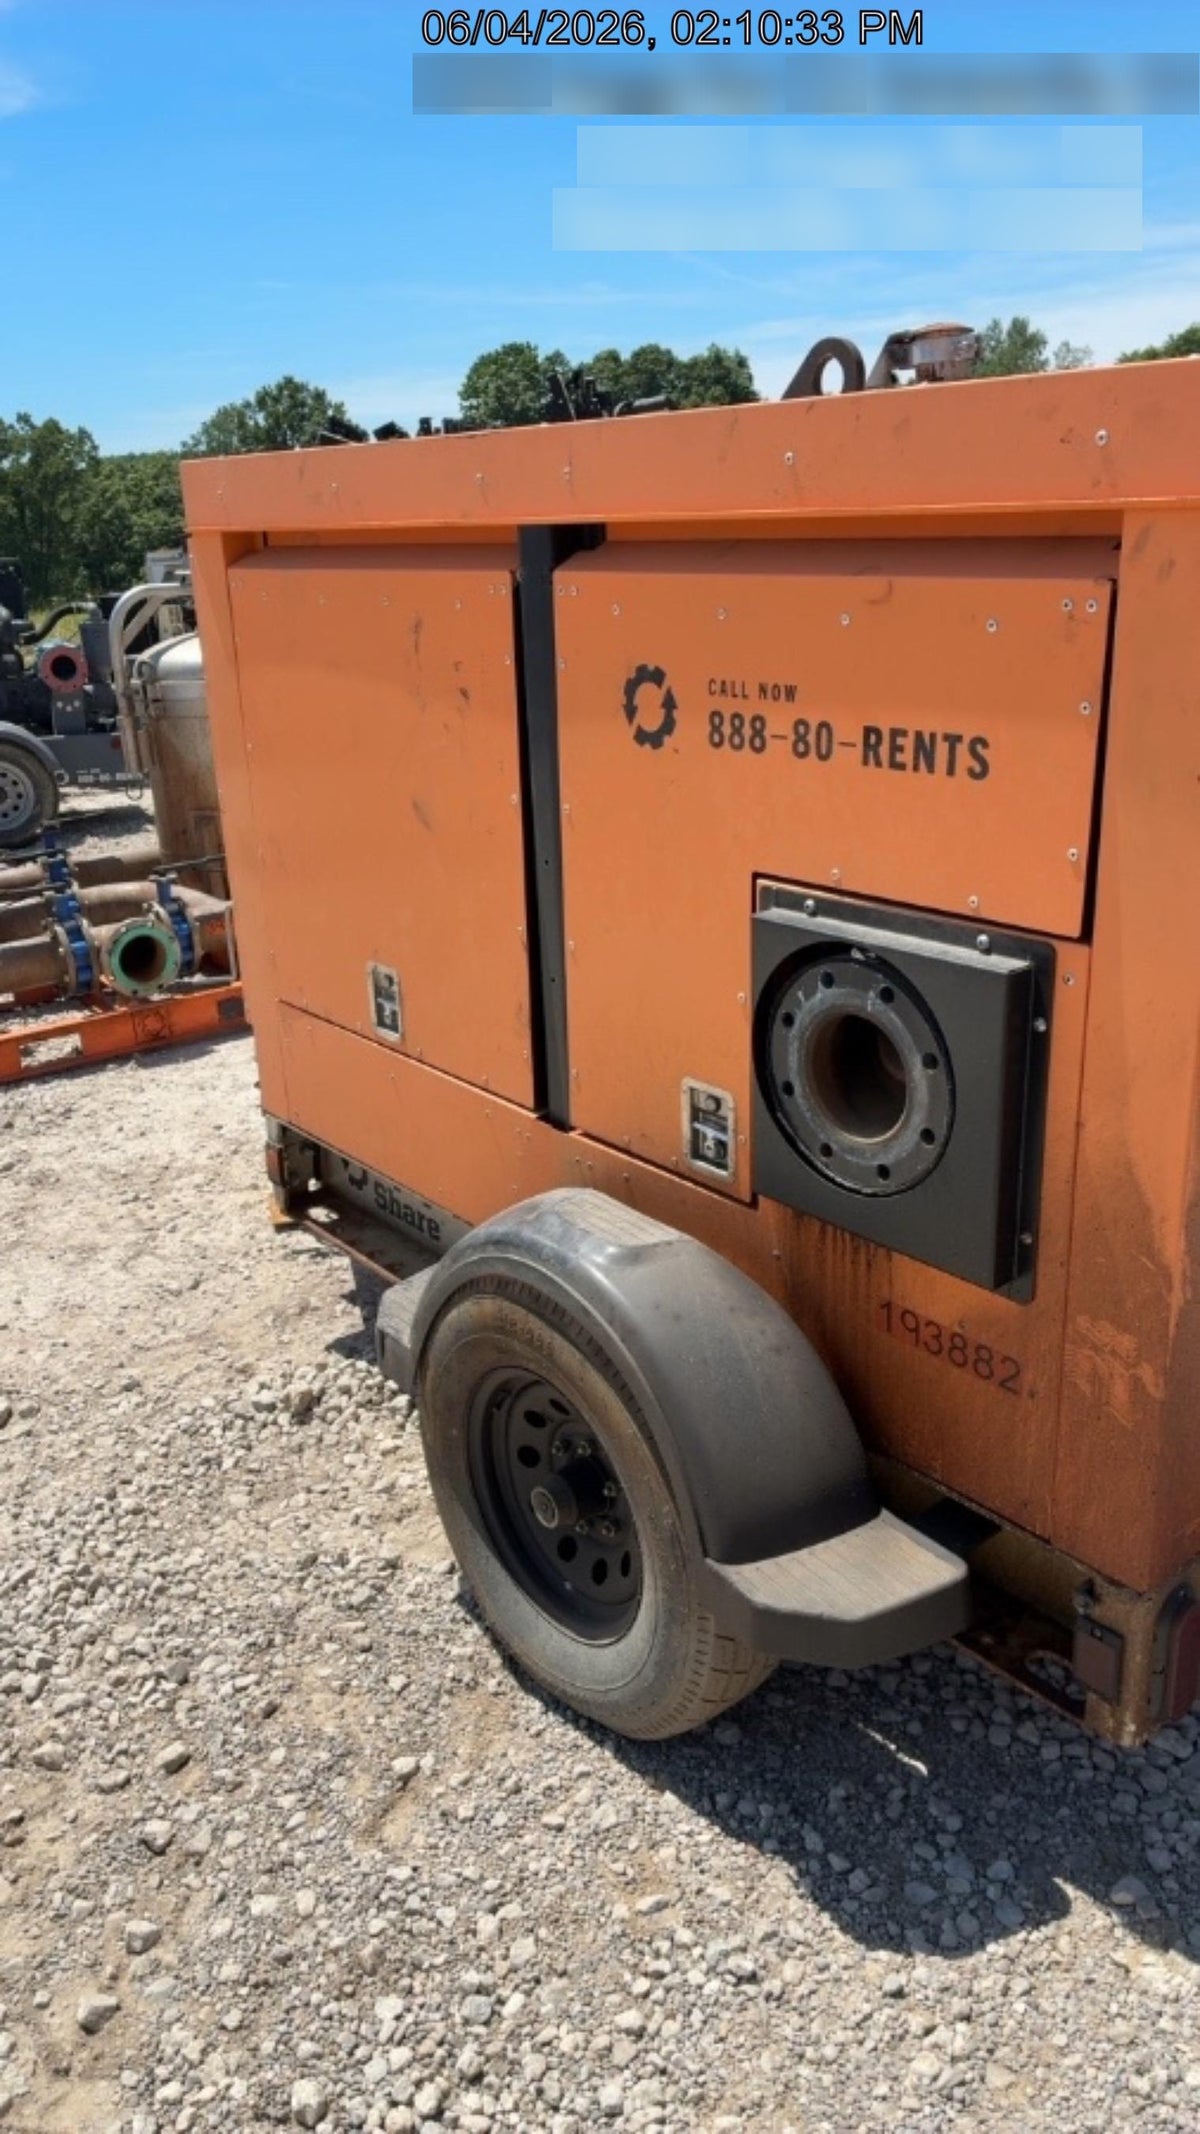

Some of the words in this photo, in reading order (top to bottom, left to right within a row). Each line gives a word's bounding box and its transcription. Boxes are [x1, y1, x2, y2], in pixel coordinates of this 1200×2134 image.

[708, 678, 750, 700] CALL
[757, 682, 799, 704] NOW
[708, 709, 991, 781] 888-80-RENTS
[373, 1181, 441, 1241] Share
[880, 1301, 1022, 1396] 193882
